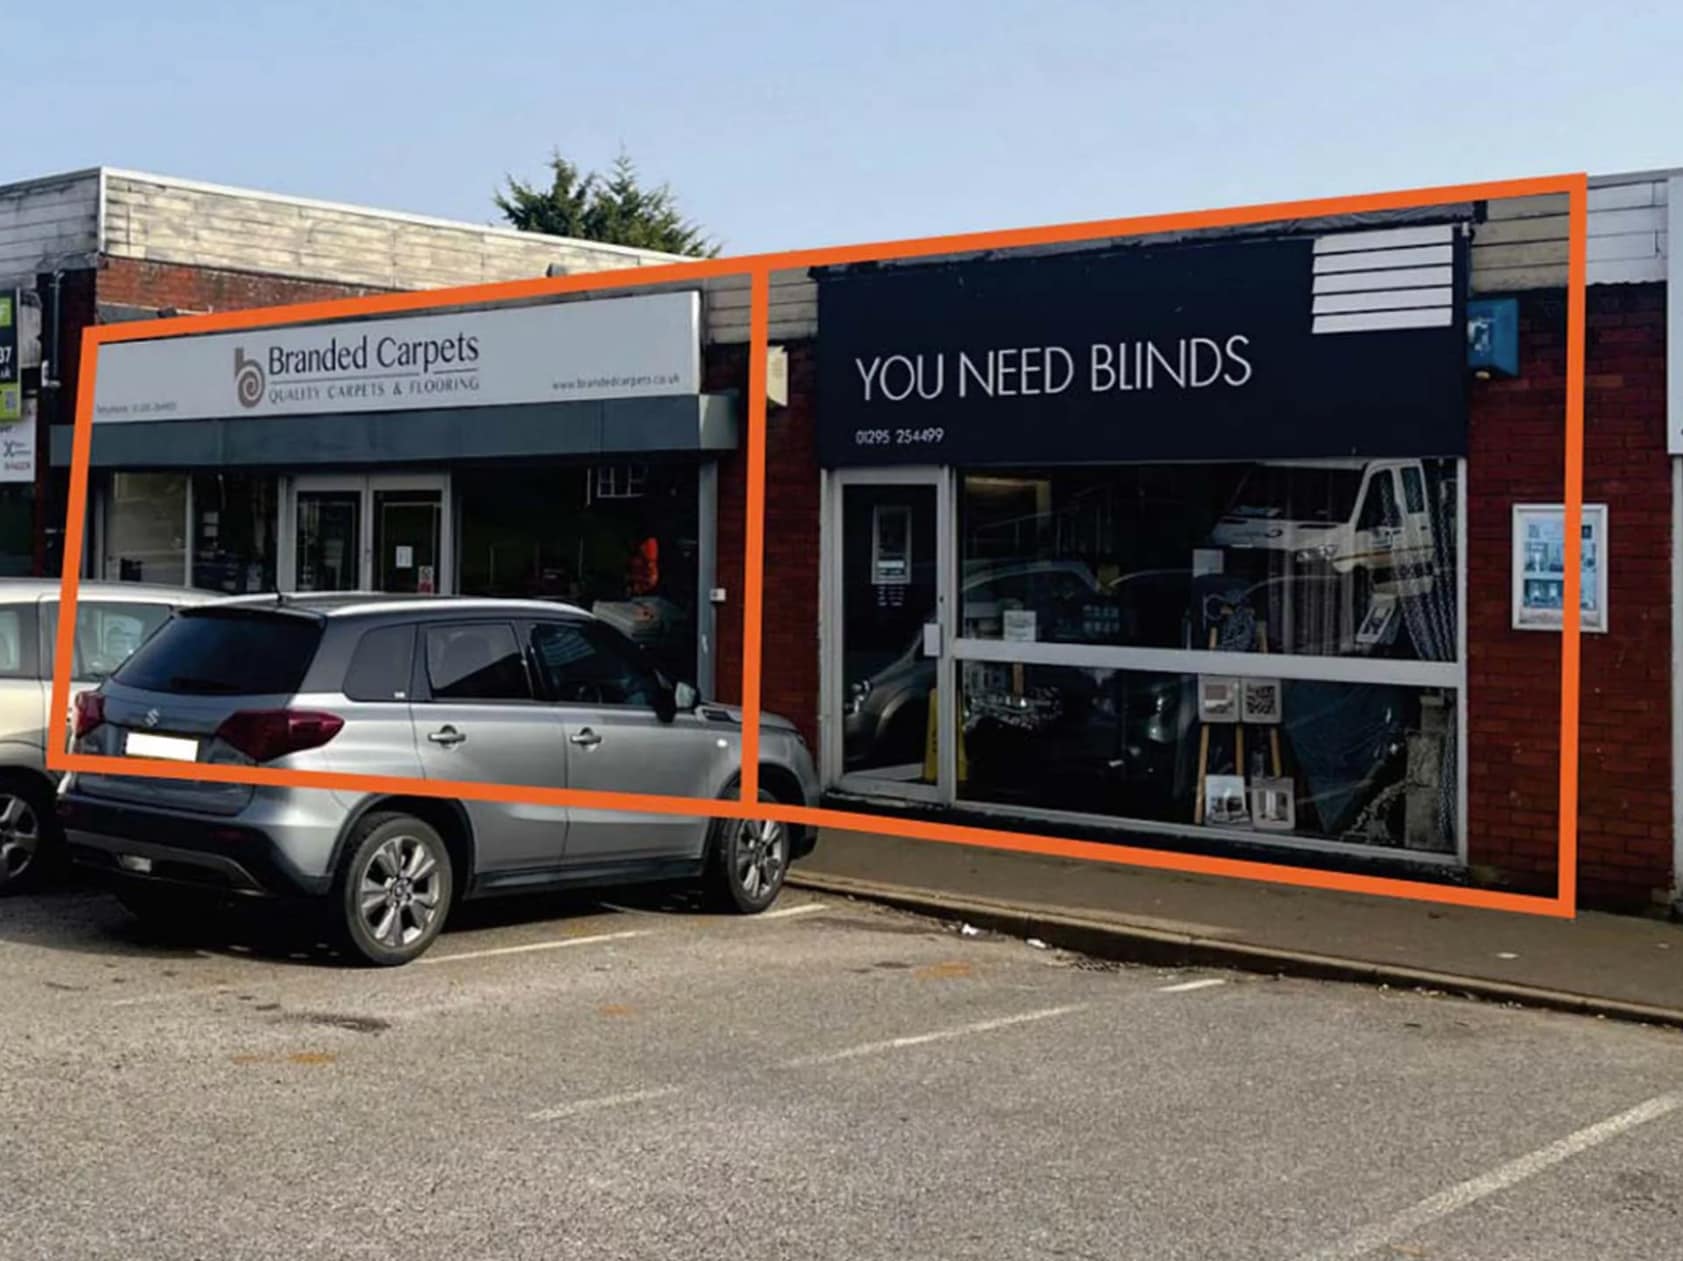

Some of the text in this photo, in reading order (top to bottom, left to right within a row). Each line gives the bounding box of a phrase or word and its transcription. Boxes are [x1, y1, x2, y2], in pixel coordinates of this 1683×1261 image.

[268, 332, 480, 376] Branded Carpets
[855, 334, 1253, 402] YOU NEED BLINDS
[268, 376, 480, 404] QUALITY CARPETS & FLOORING
[855, 427, 944, 444] 01295 254499
